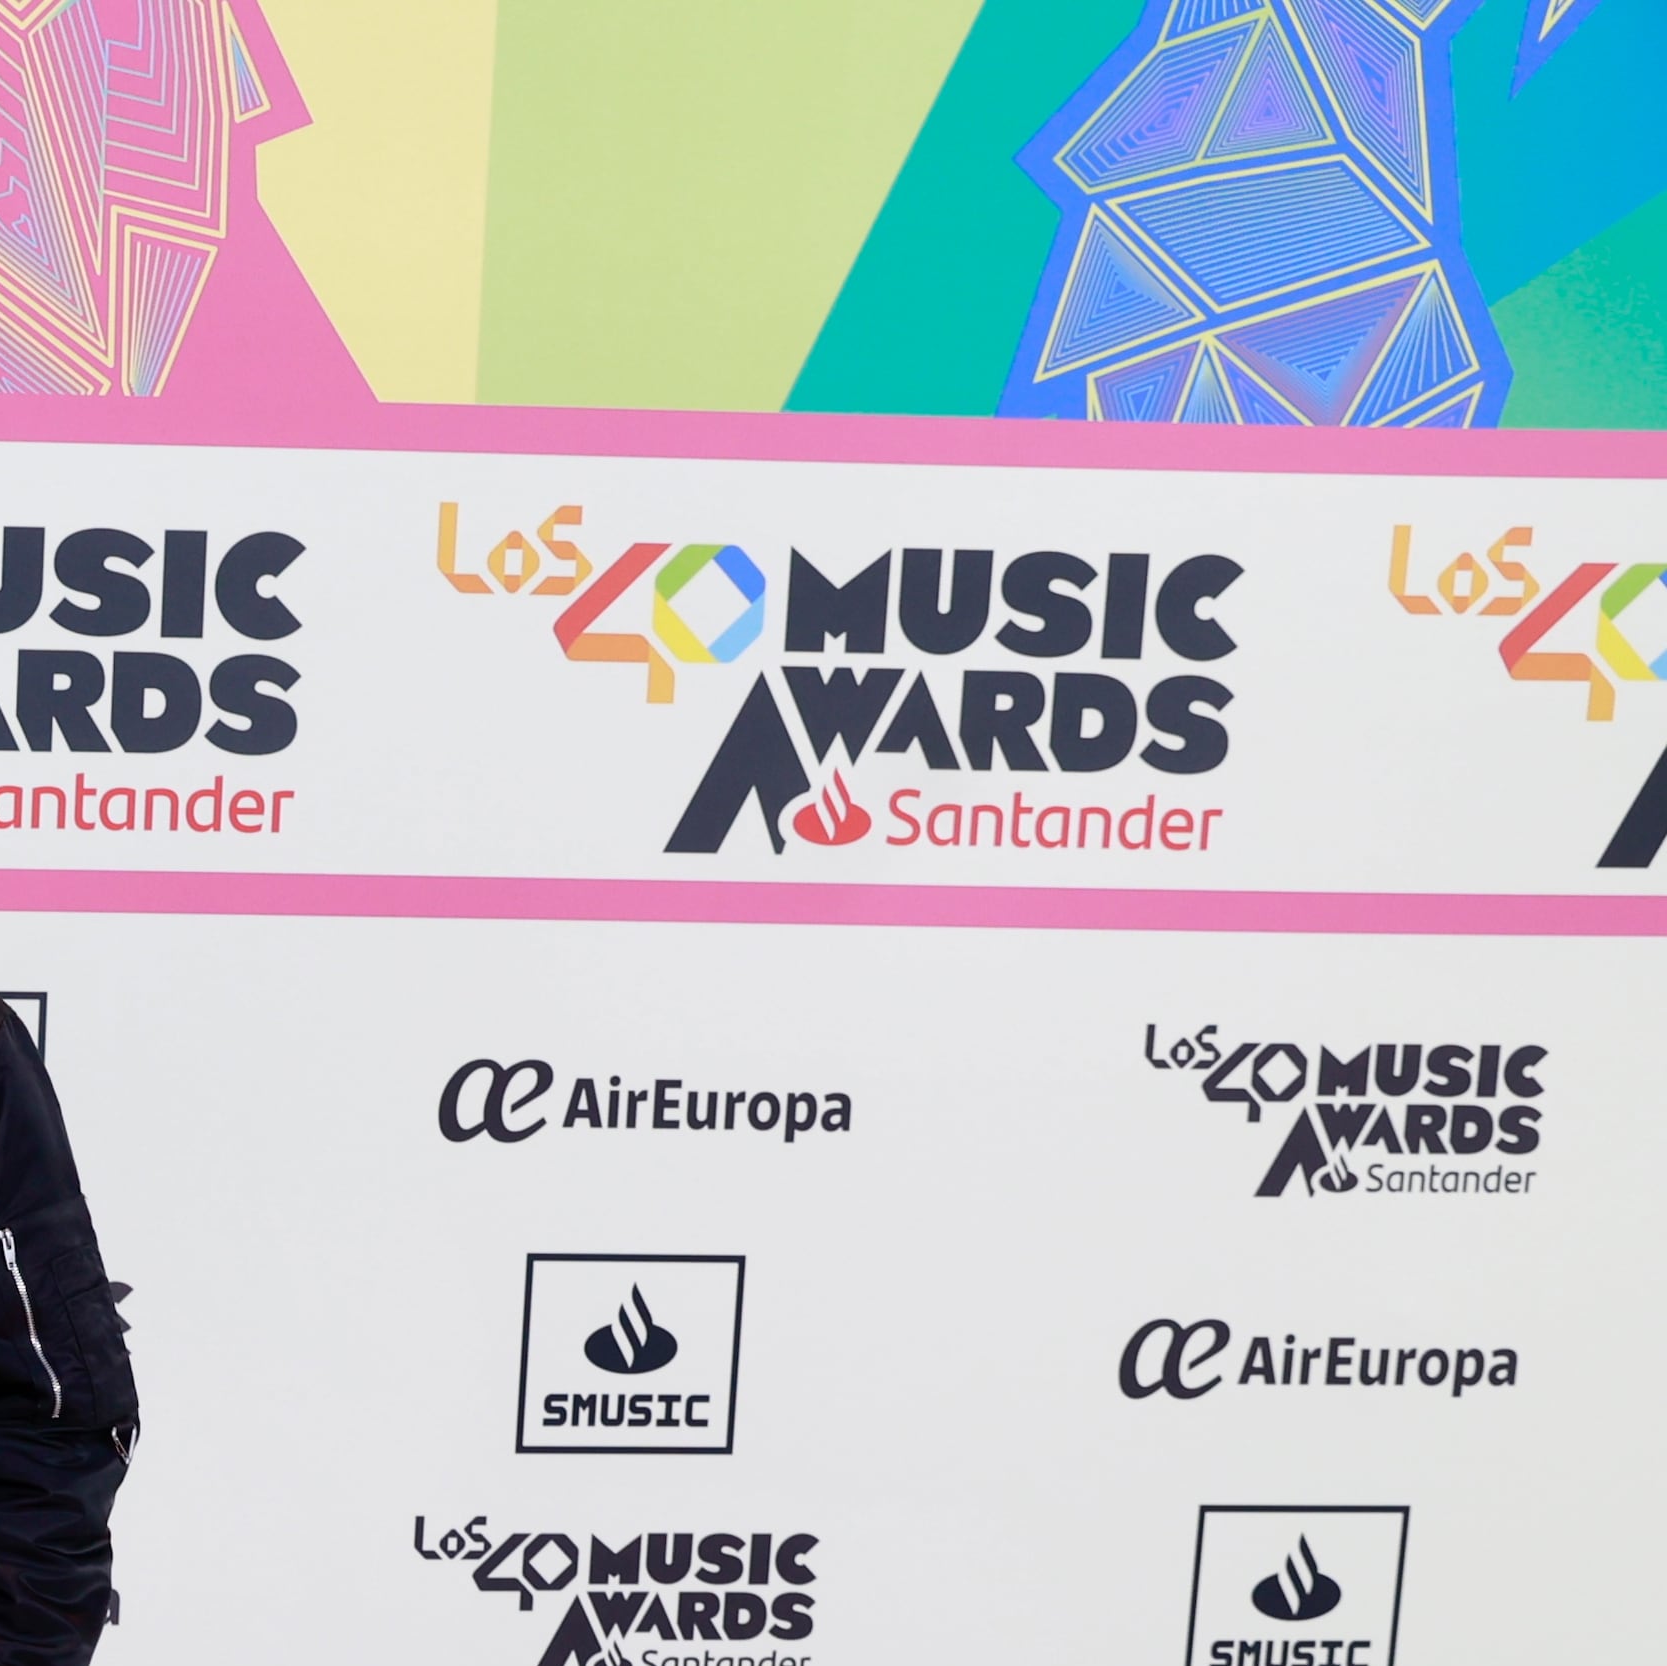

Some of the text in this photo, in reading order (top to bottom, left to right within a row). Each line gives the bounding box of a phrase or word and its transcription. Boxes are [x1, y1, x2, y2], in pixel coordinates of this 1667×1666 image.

[553, 543, 766, 704] 40
[784, 546, 1245, 662] MUSIC
[662, 666, 1235, 855] AWARDS
[885, 789, 1223, 852] Santander
[563, 1075, 853, 1143] AirEuropa
[1202, 1043, 1308, 1122] 40
[1317, 1044, 1549, 1098] MUSIC
[1254, 1104, 1543, 1197] AWARDS
[1365, 1164, 1537, 1193] Santander
[1238, 1334, 1518, 1397] AirEuropa
[542, 1394, 710, 1427] SMUSIC
[472, 1533, 579, 1611] 40
[589, 1533, 820, 1585] MUSIC
